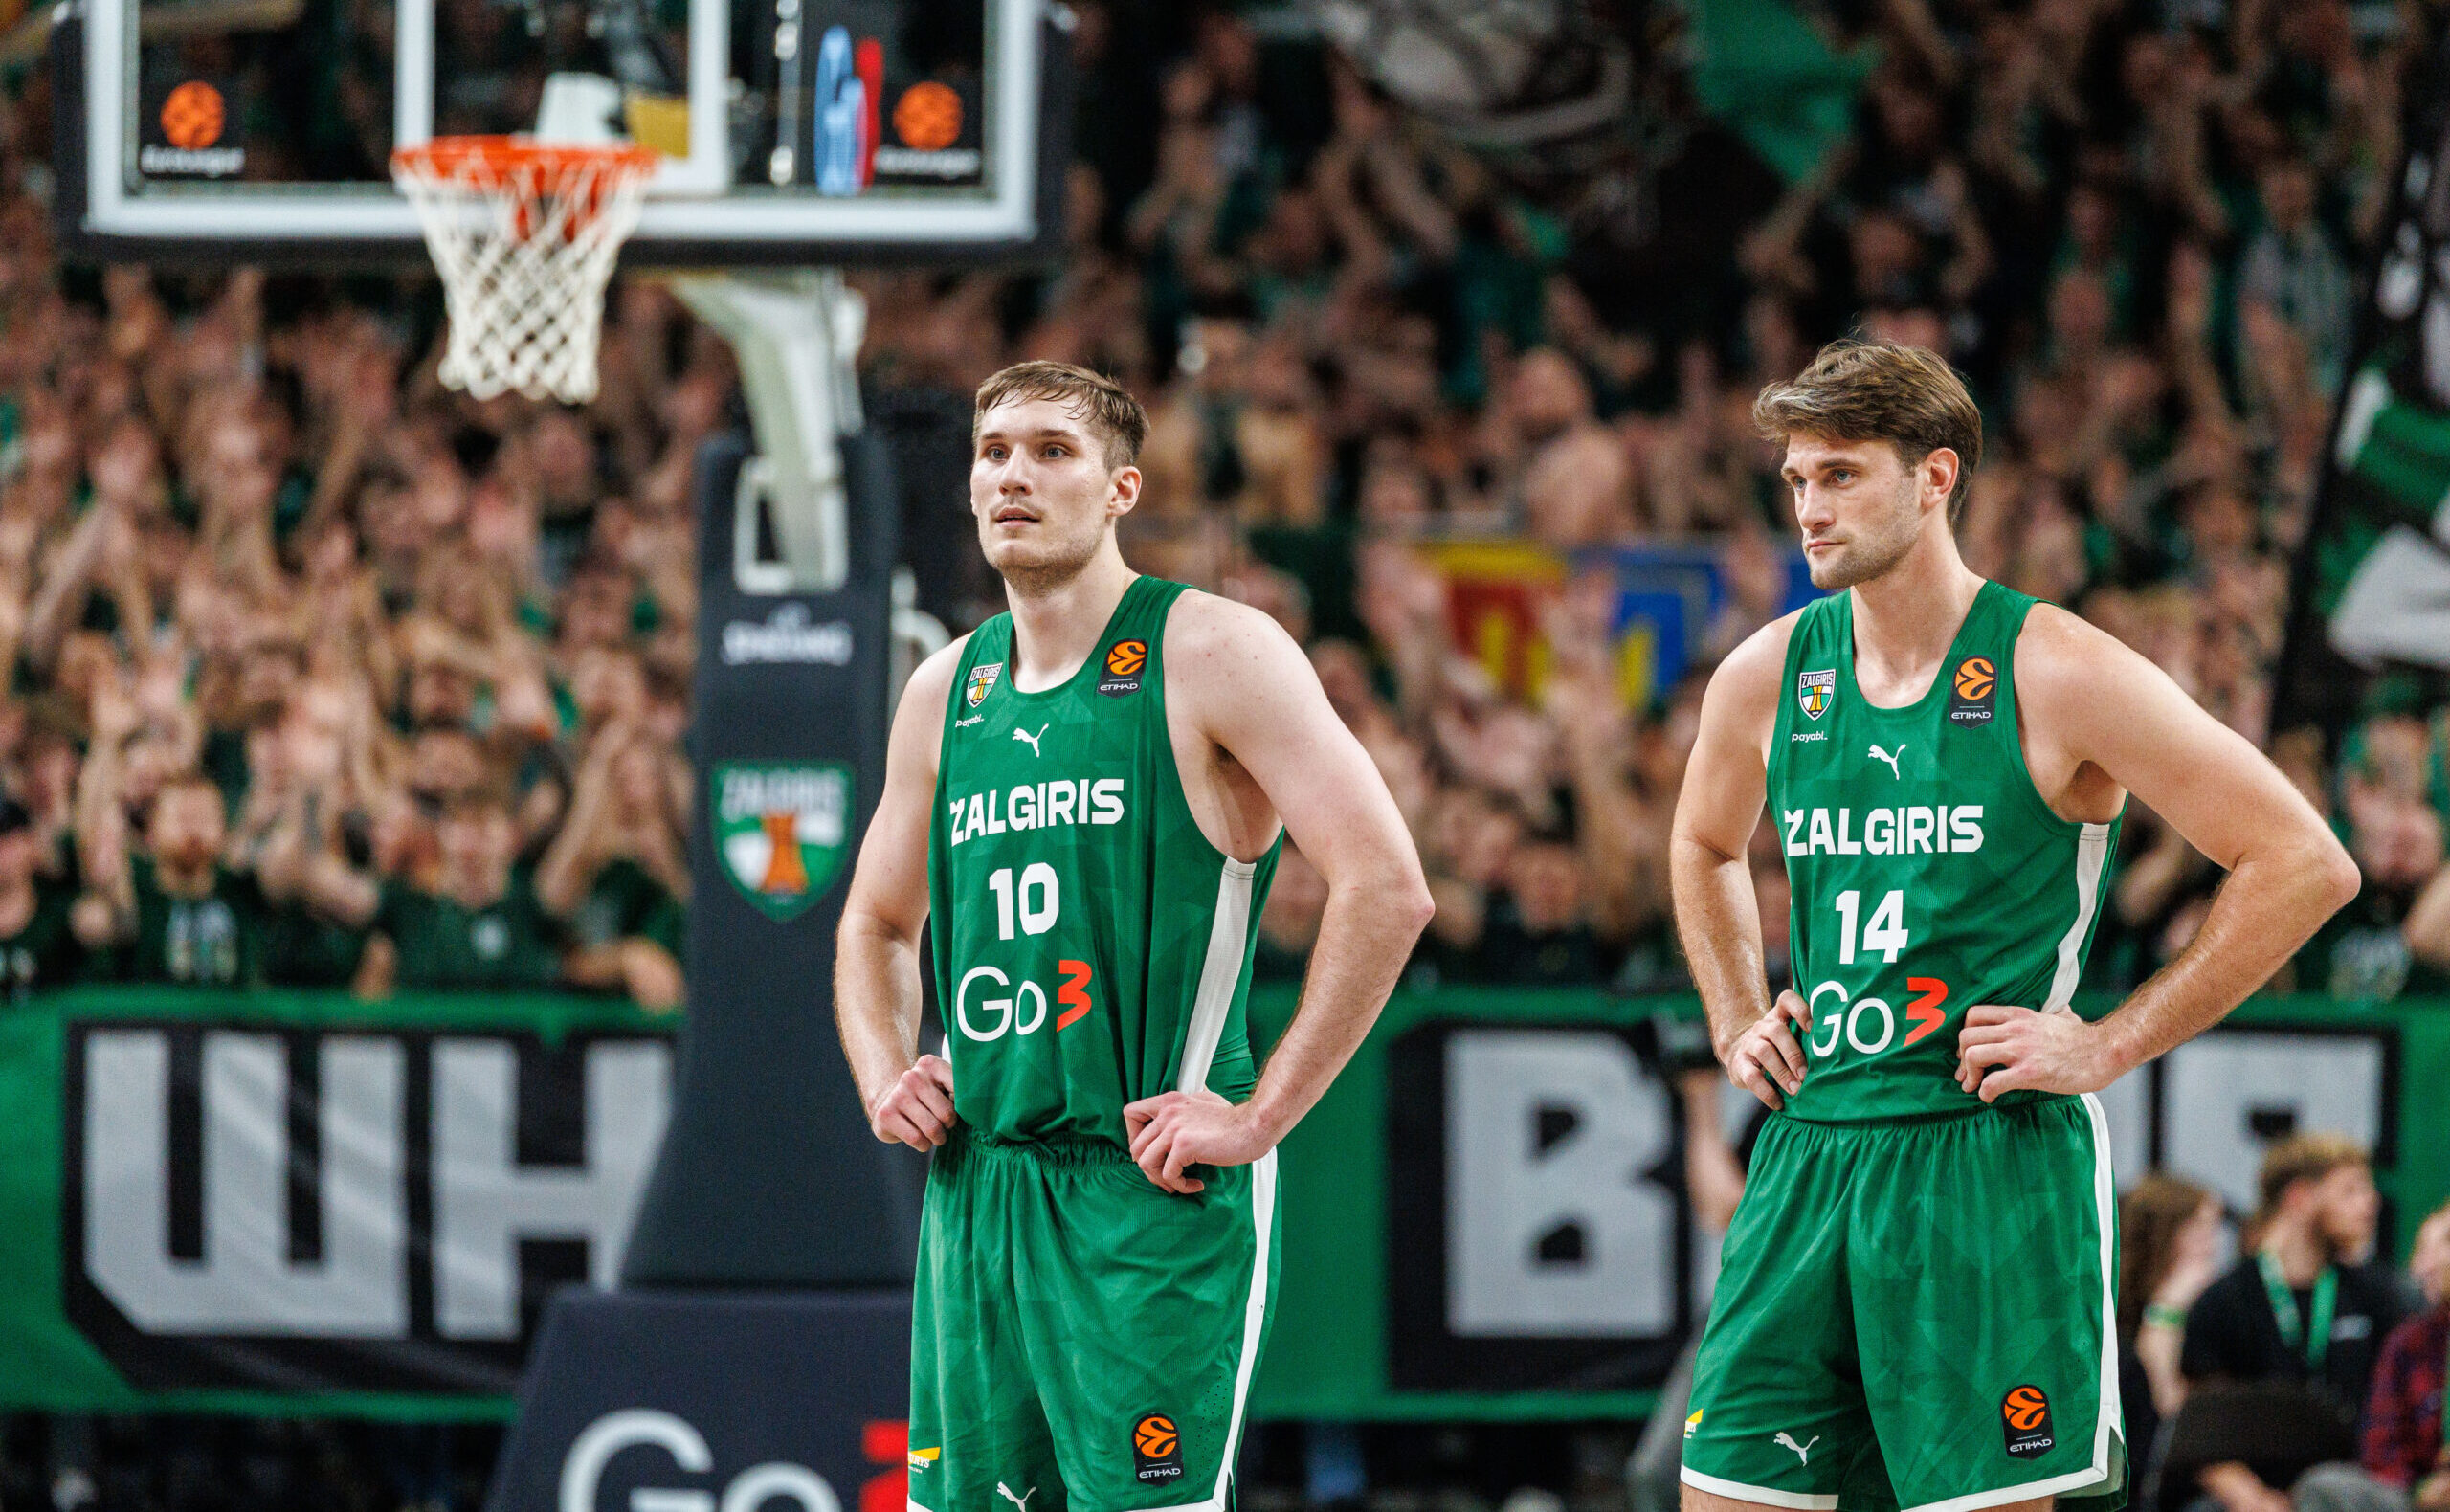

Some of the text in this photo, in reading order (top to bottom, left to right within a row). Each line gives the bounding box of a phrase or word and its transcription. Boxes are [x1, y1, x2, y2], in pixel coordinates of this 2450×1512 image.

[970, 667, 1000, 681] ZALGIRIS
[1802, 673, 1833, 688] ZALGIRIS
[1951, 711, 1992, 720] ETIHAD
[949, 778, 1125, 847] ZALGIRIS
[1784, 805, 1984, 856] ZALGIRIS
[989, 862, 1059, 941] 10
[1835, 889, 1909, 965] 14
[957, 959, 1093, 1042] Go3
[1810, 976, 1949, 1057] Go3
[2010, 1438, 2052, 1453] ETIHAD
[1139, 1467, 1181, 1479] ETIHAD
